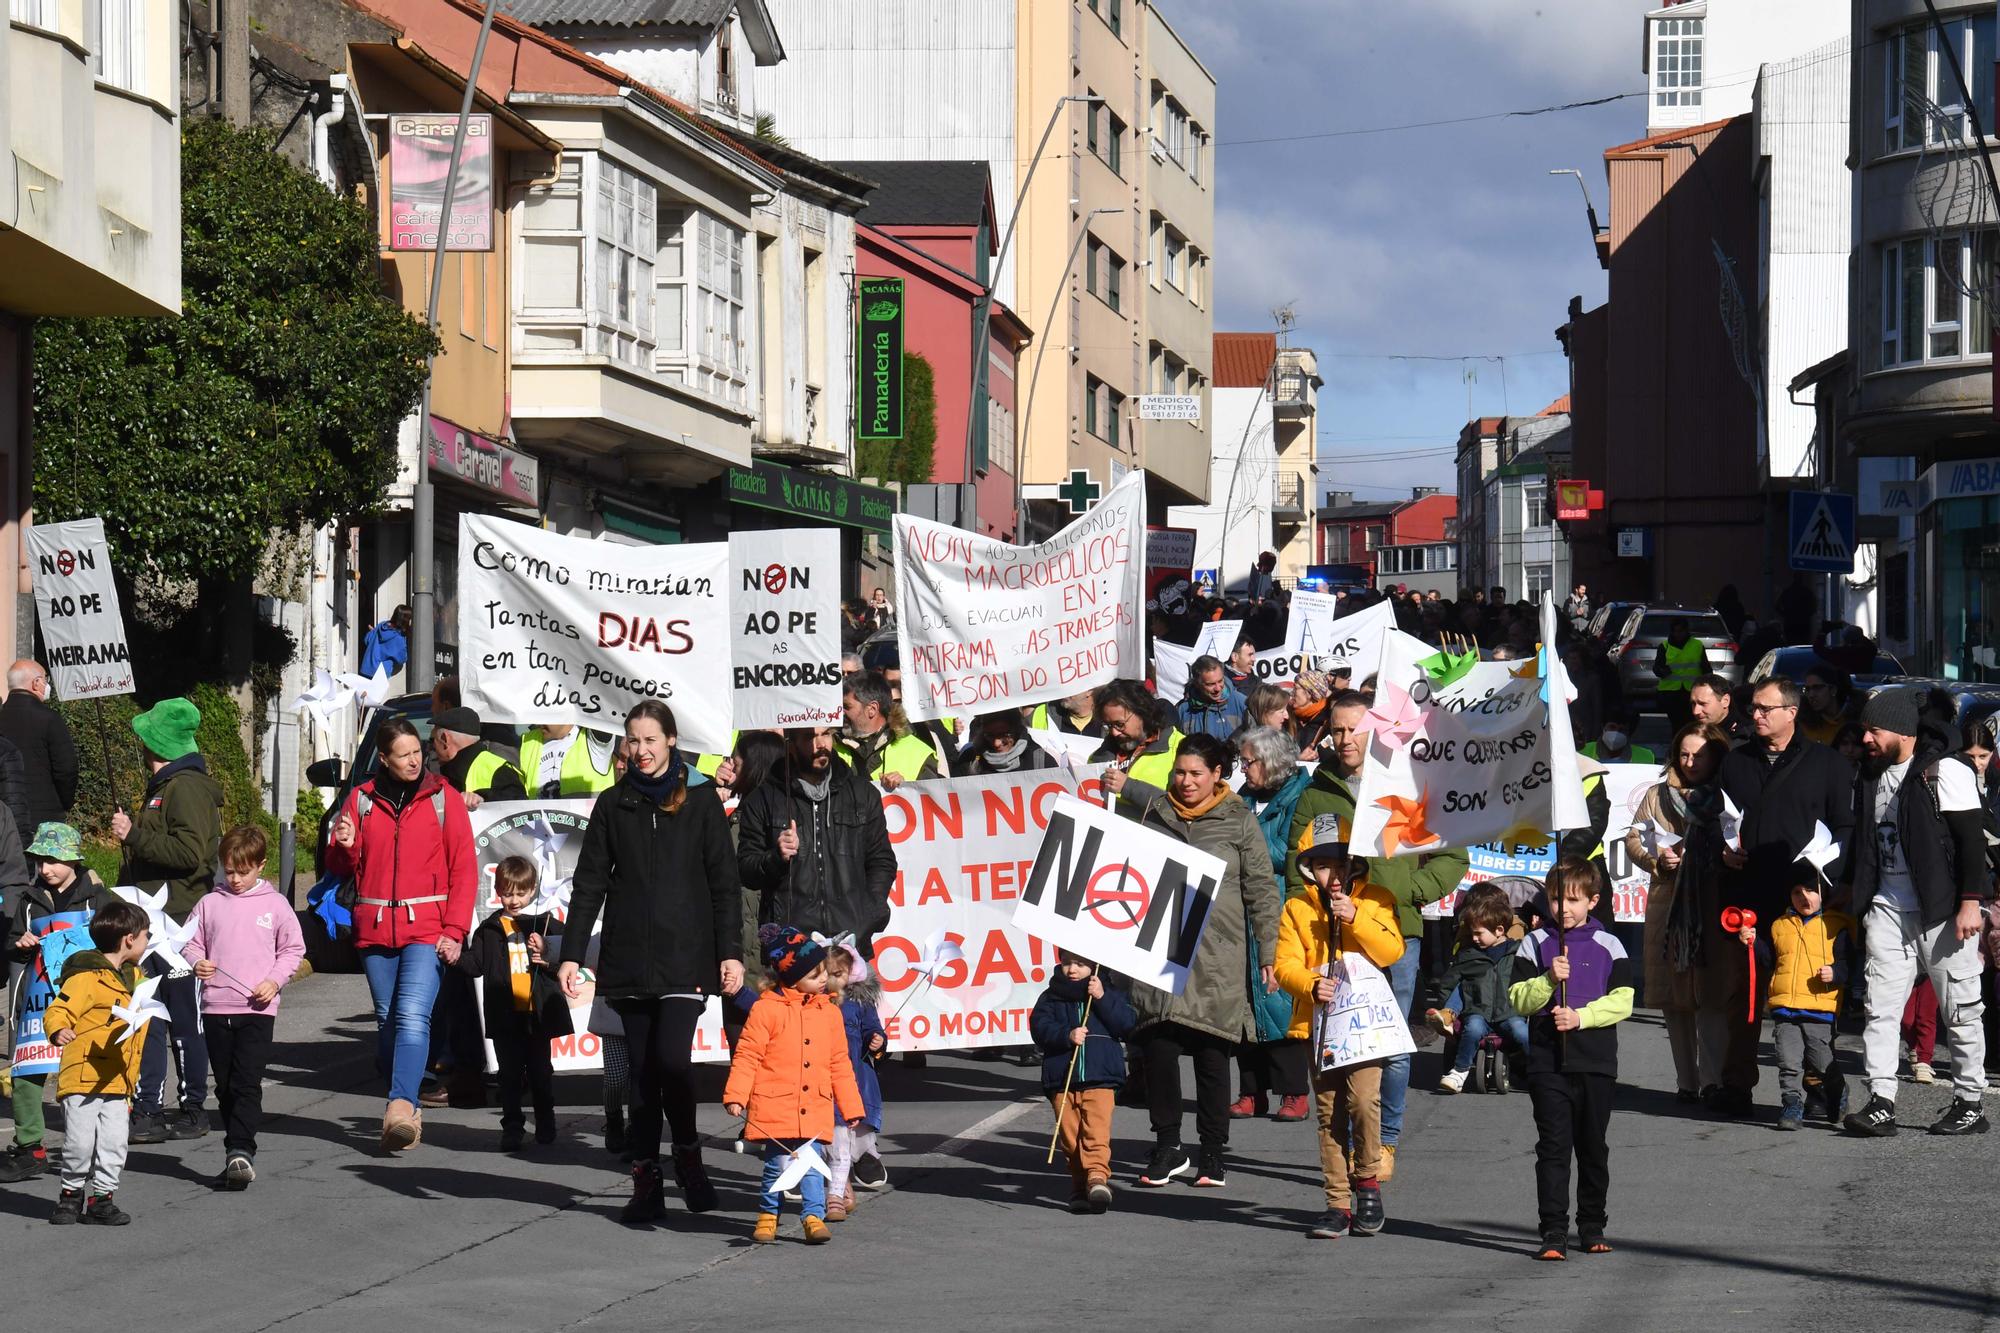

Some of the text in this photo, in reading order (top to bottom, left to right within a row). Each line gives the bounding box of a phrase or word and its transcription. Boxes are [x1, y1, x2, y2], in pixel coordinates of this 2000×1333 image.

[873, 332, 889, 433] Panadería
[455, 431, 502, 489] Caravel
[729, 467, 767, 495] Panadería
[794, 481, 831, 513] CAÑÁS
[908, 525, 974, 563] NON
[985, 543, 1017, 561] AOS
[40, 549, 96, 577] NON
[473, 542, 570, 585] Como
[743, 563, 810, 595] NON
[929, 581, 944, 593] DE
[51, 593, 102, 619] AO PE
[921, 614, 952, 630] QUE
[967, 605, 1043, 626] EVACUAN
[597, 611, 694, 655] DIAS
[744, 610, 817, 635] AO PE
[772, 642, 788, 655] AS
[912, 638, 998, 674] MEIRAMA
[1027, 629, 1050, 655] AS
[1056, 602, 1132, 646] TRAVESAS
[48, 642, 130, 668] MEIRAMA
[482, 651, 516, 670] en
[525, 640, 568, 675] tan
[583, 662, 673, 698] poucos
[1021, 667, 1047, 692] DO
[1057, 639, 1120, 685] BENTO
[733, 662, 842, 689] ENCROBAS
[1410, 738, 1456, 763] QUE
[1442, 790, 1488, 813] SON
[488, 821, 512, 838] VAL
[532, 812, 576, 827] BRCIA
[1468, 852, 1552, 873] LIBRES DE
[918, 867, 954, 906] A
[1022, 809, 1218, 969] NON
[909, 1015, 931, 1039] O
